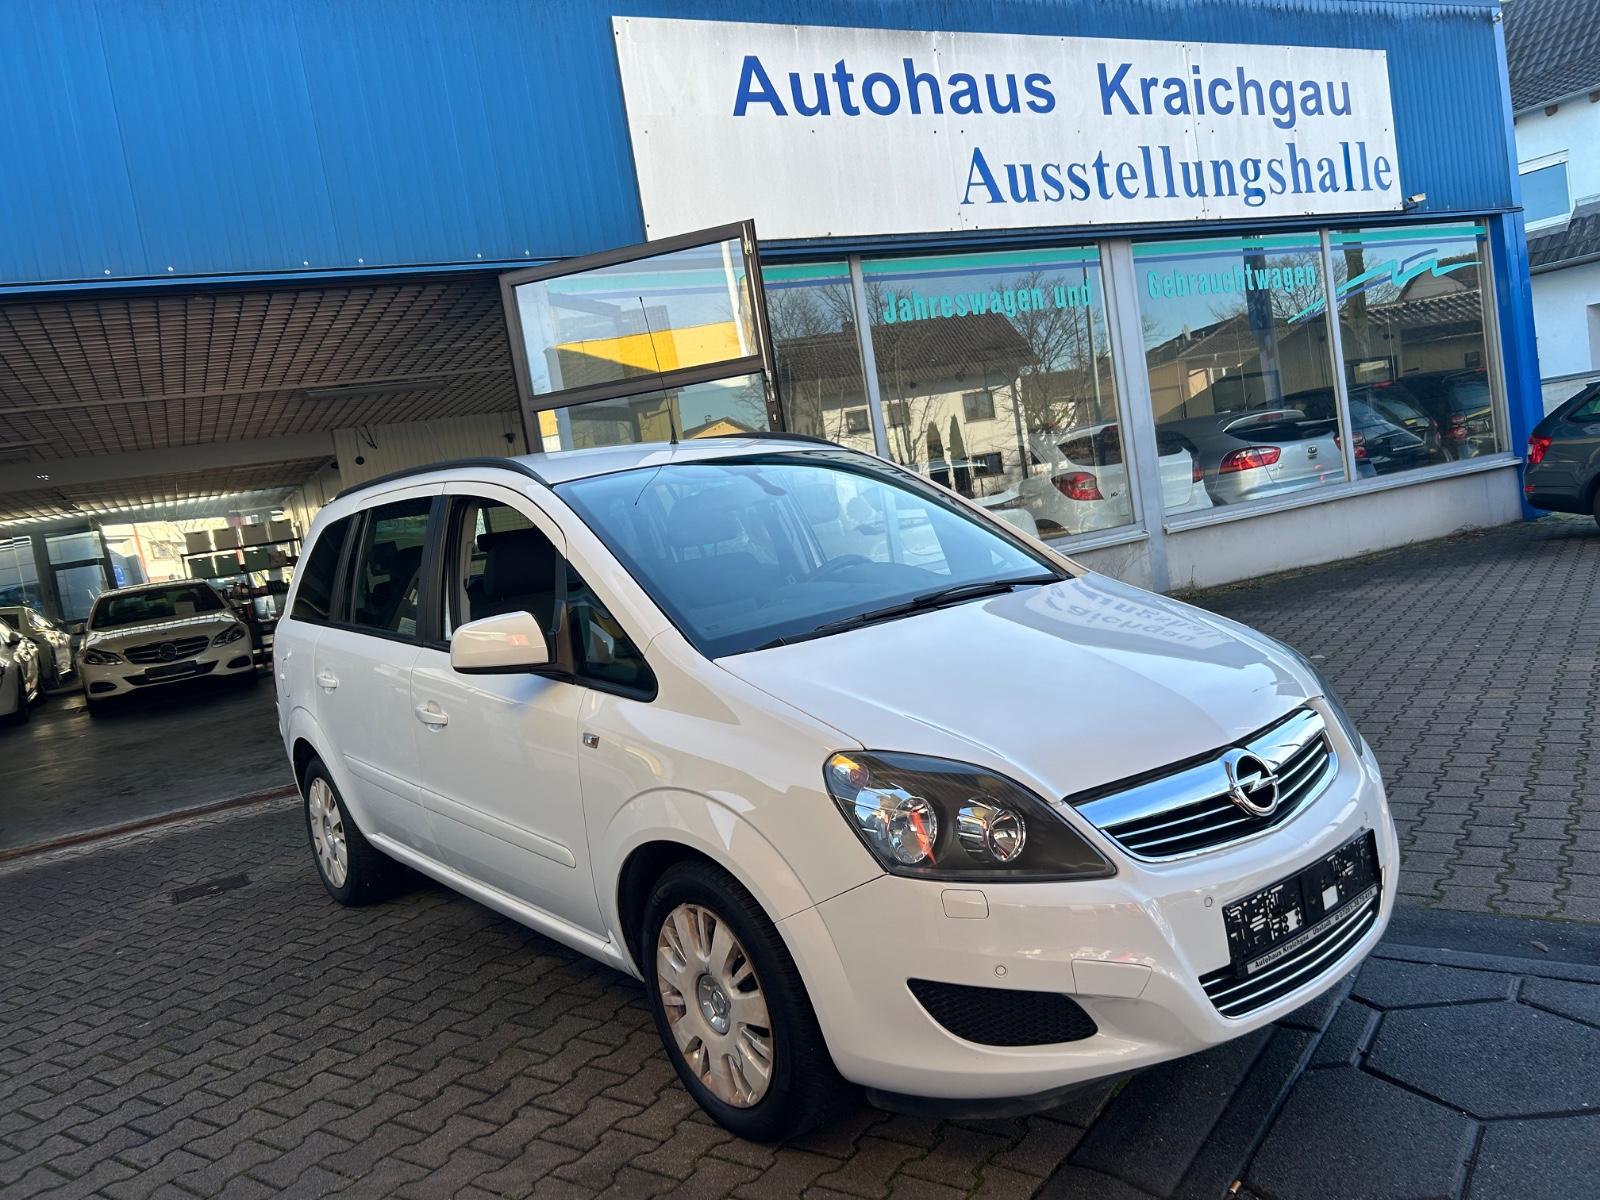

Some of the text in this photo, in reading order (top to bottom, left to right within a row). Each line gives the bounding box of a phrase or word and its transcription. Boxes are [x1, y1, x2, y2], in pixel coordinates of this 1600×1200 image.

[733, 56, 1351, 129] Autohaus Kraichgau
[961, 142, 1393, 206] Ausstellungshalle
[883, 278, 1092, 325] Jahreswagen und
[1147, 264, 1316, 299] Gebrauchtwagen
[1254, 951, 1282, 969] Autohaus
